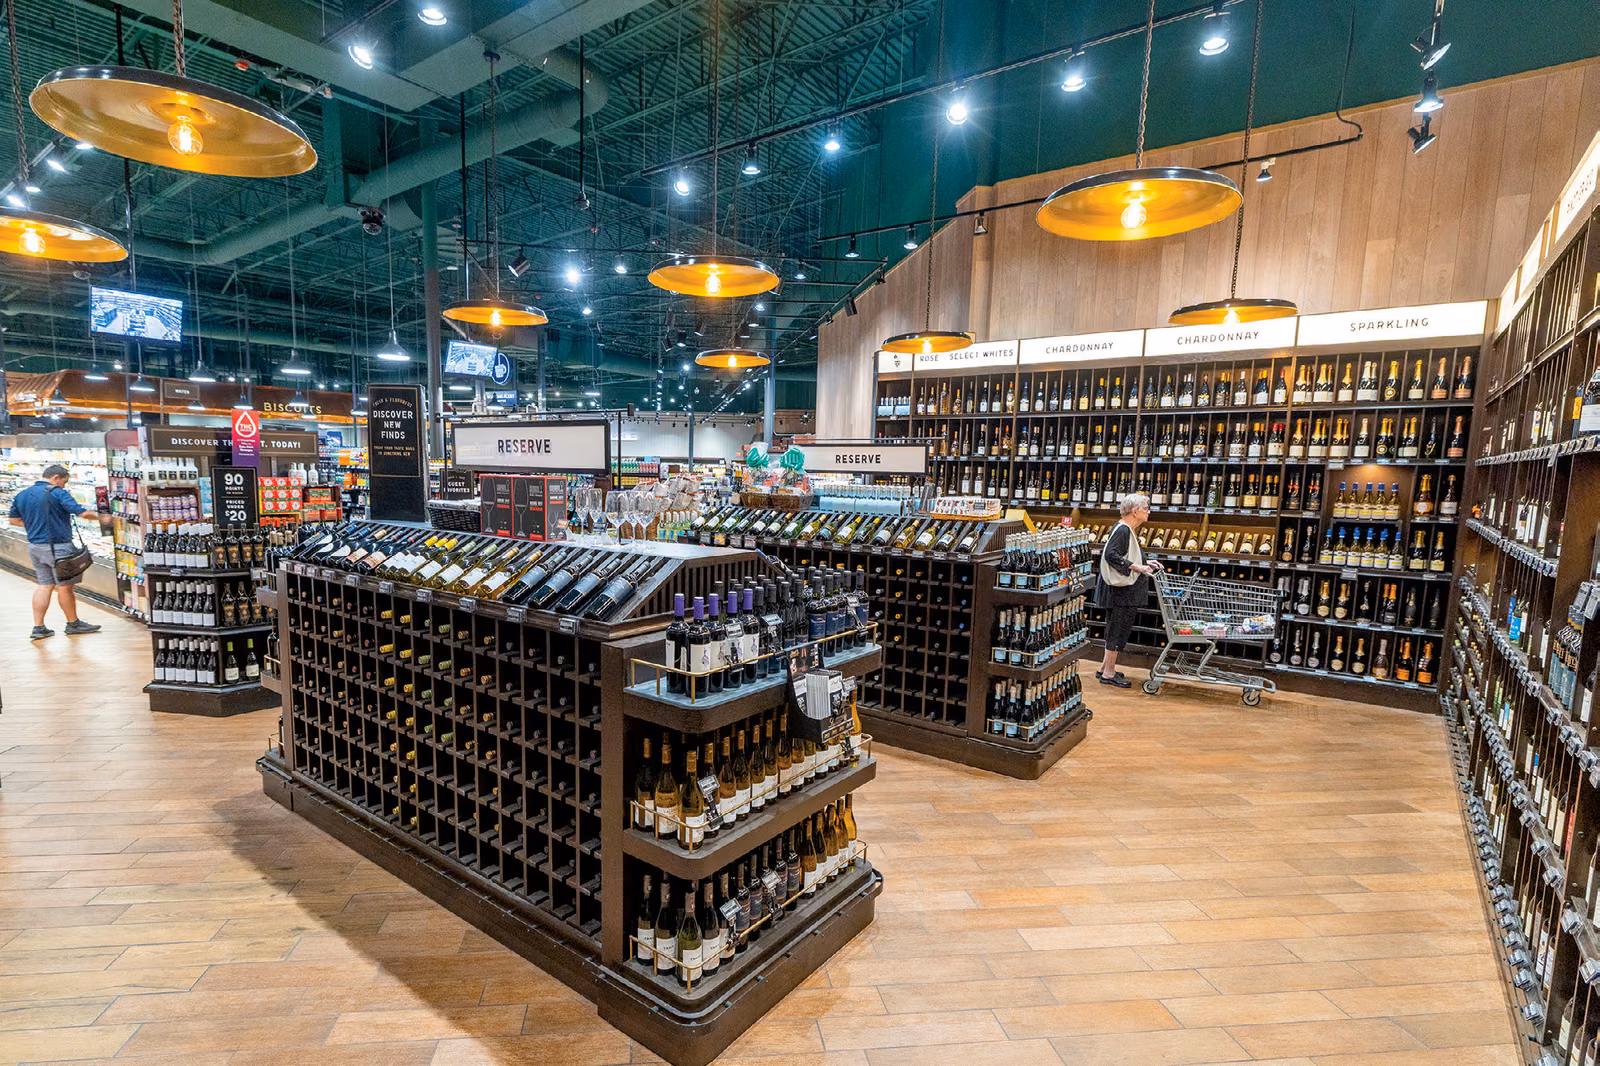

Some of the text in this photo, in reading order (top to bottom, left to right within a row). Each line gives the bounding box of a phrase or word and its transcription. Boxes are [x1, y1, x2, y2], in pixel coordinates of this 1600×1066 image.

[1350, 318, 1429, 332] SPARKLING
[1176, 331, 1260, 346] CHARDONNAY
[1045, 342, 1114, 355] CHARDONNAY
[949, 352, 979, 361] SELECT
[983, 349, 1014, 358] WHITES
[372, 410, 413, 419] DISCOVER
[383, 420, 402, 429] NEW
[381, 431, 406, 439] FINDS
[171, 437, 219, 446] DISCOVER
[497, 439, 551, 453] RESERVE
[835, 454, 882, 464] RESERVE
[224, 473, 244, 485] 90
[225, 510, 247, 521] $20
